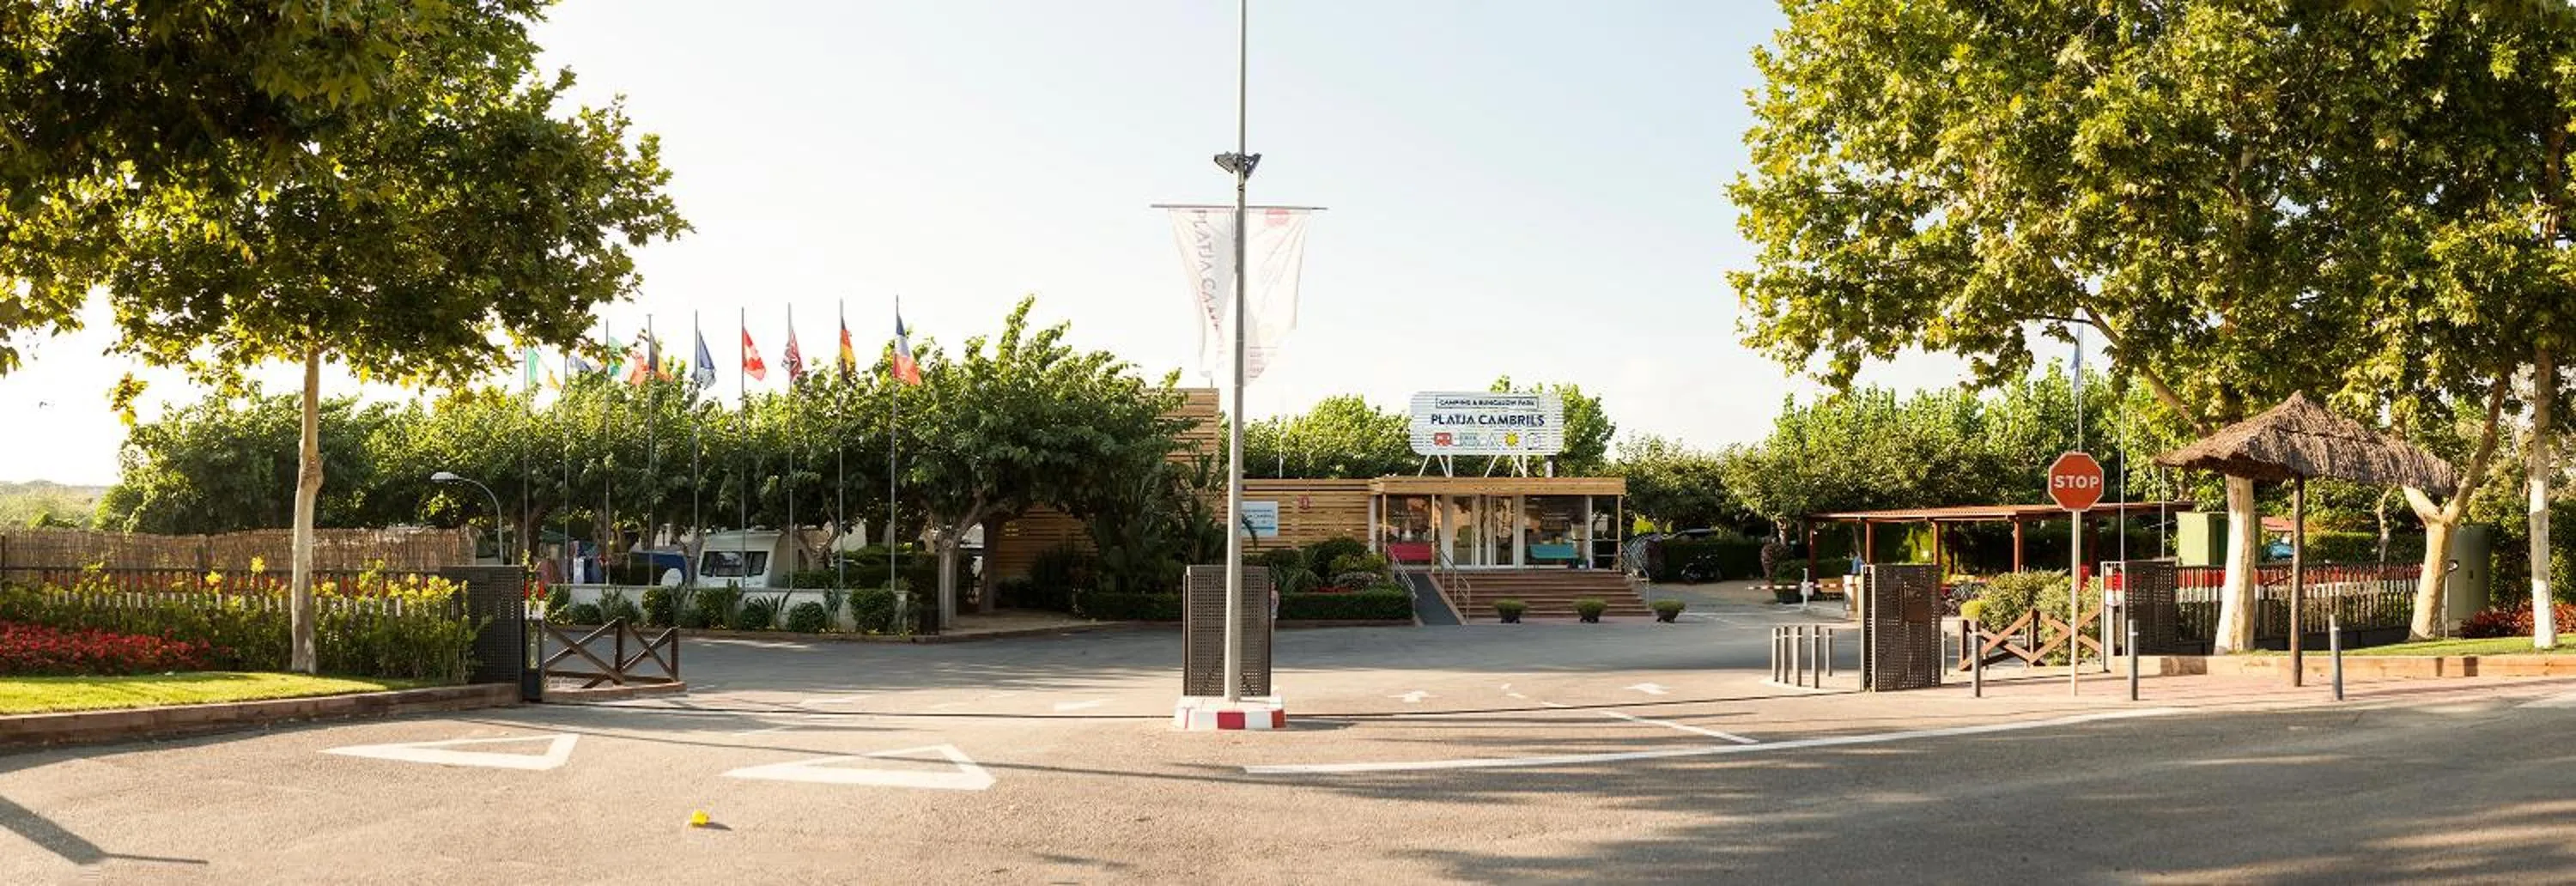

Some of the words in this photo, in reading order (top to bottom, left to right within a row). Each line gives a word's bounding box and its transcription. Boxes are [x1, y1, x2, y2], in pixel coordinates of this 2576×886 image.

[1193, 209, 1212, 275] PLATJA
[1431, 414, 1475, 425] PLATJA
[1478, 414, 1545, 426] CAMBRILS
[2054, 475, 2099, 489] STOP
